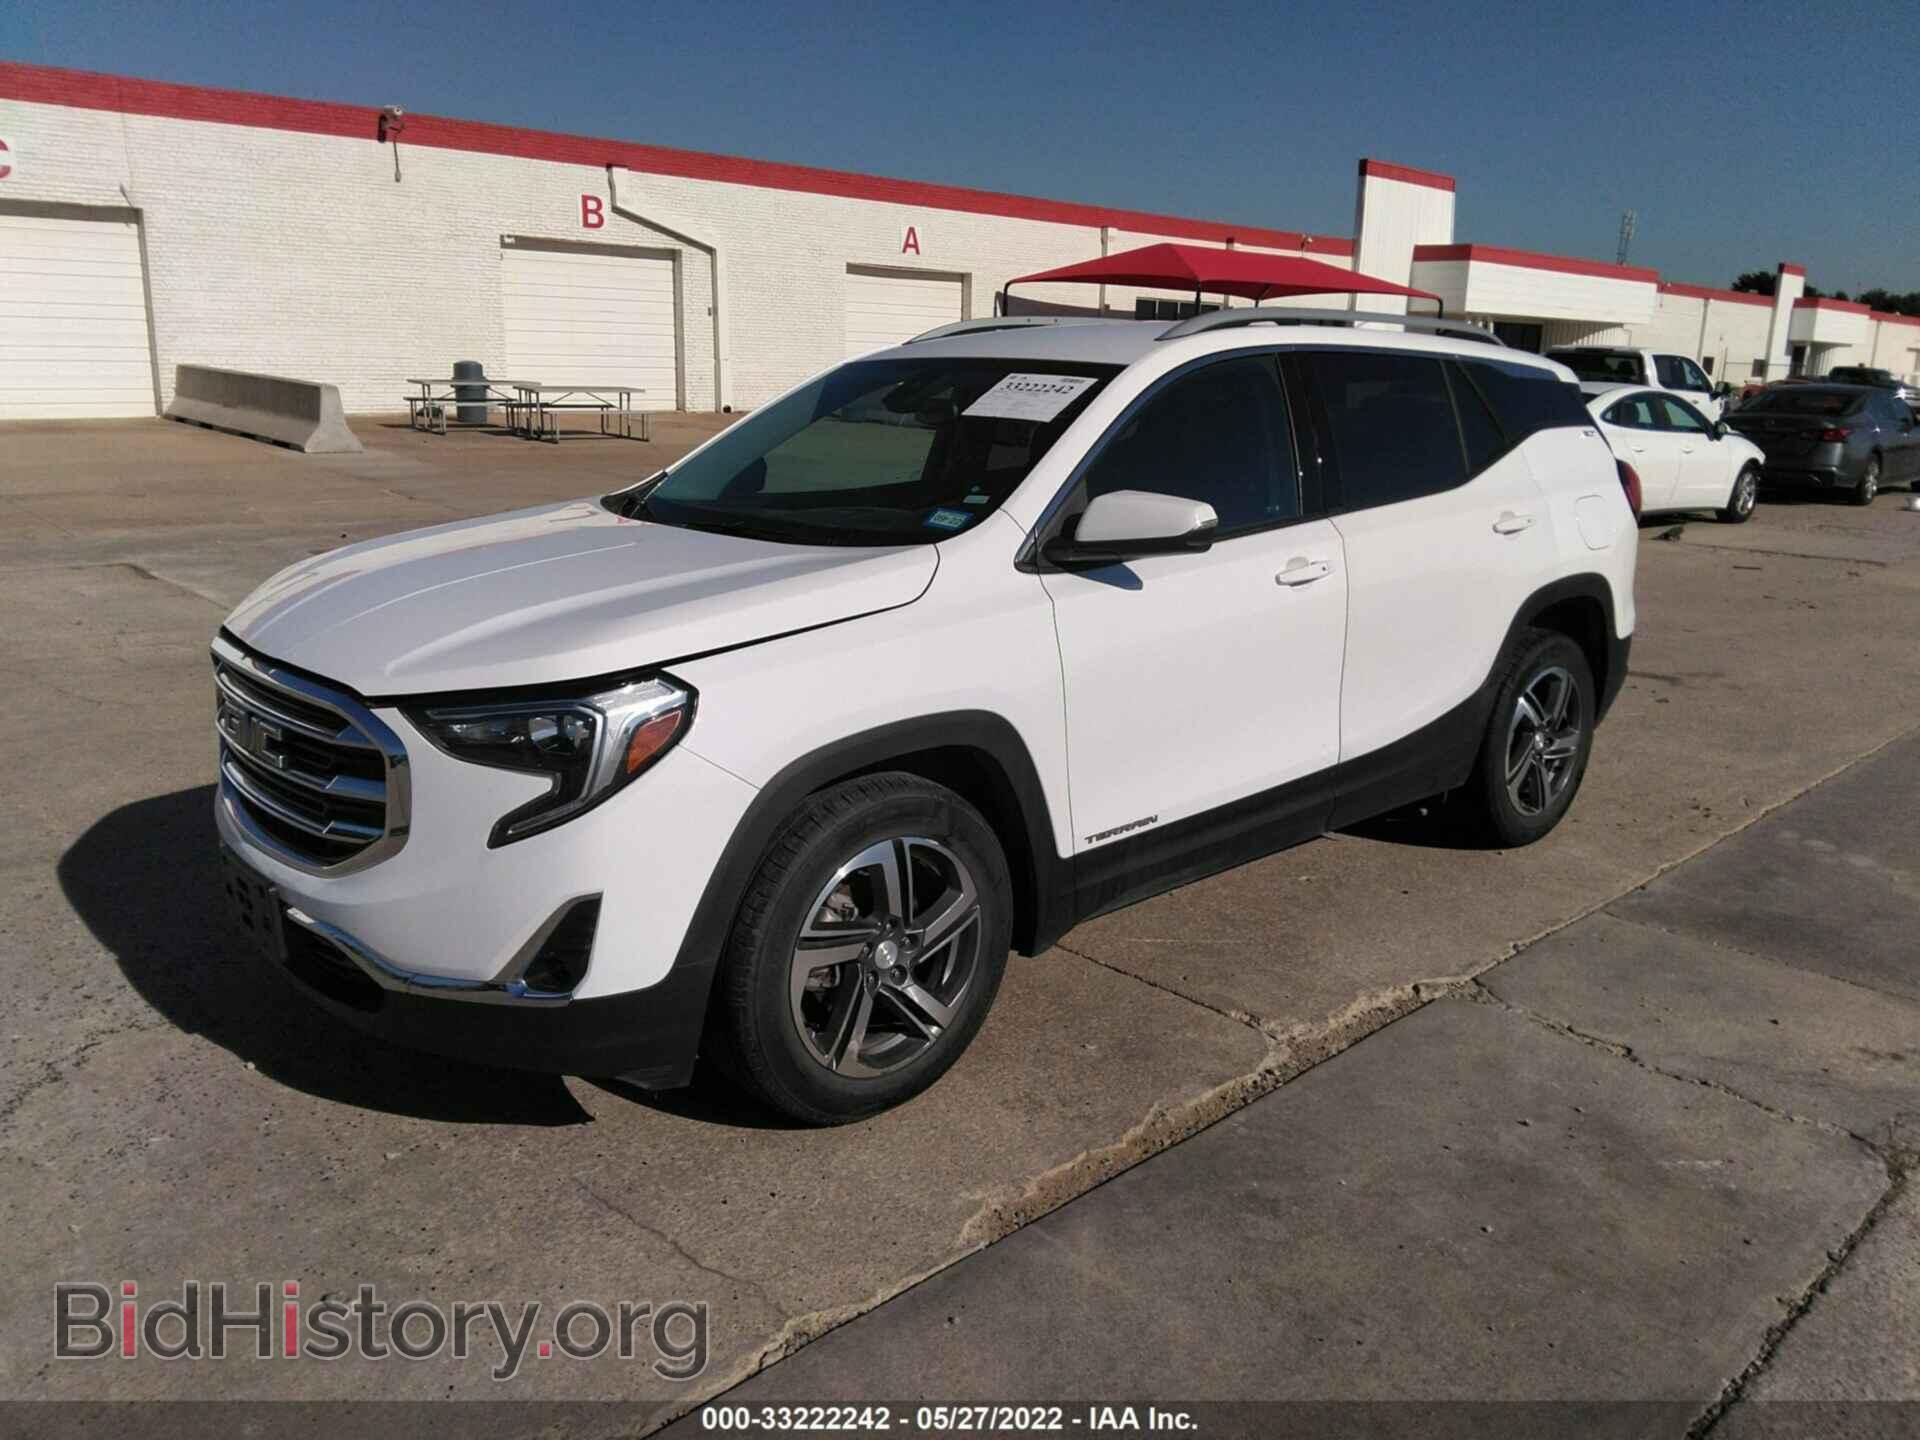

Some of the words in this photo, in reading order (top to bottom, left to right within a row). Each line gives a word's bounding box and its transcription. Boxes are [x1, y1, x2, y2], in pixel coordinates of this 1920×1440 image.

[581, 194, 604, 229] B
[902, 226, 920, 255] A
[1000, 381, 1075, 395] 33222242
[1085, 814, 1158, 844] TERRAIN
